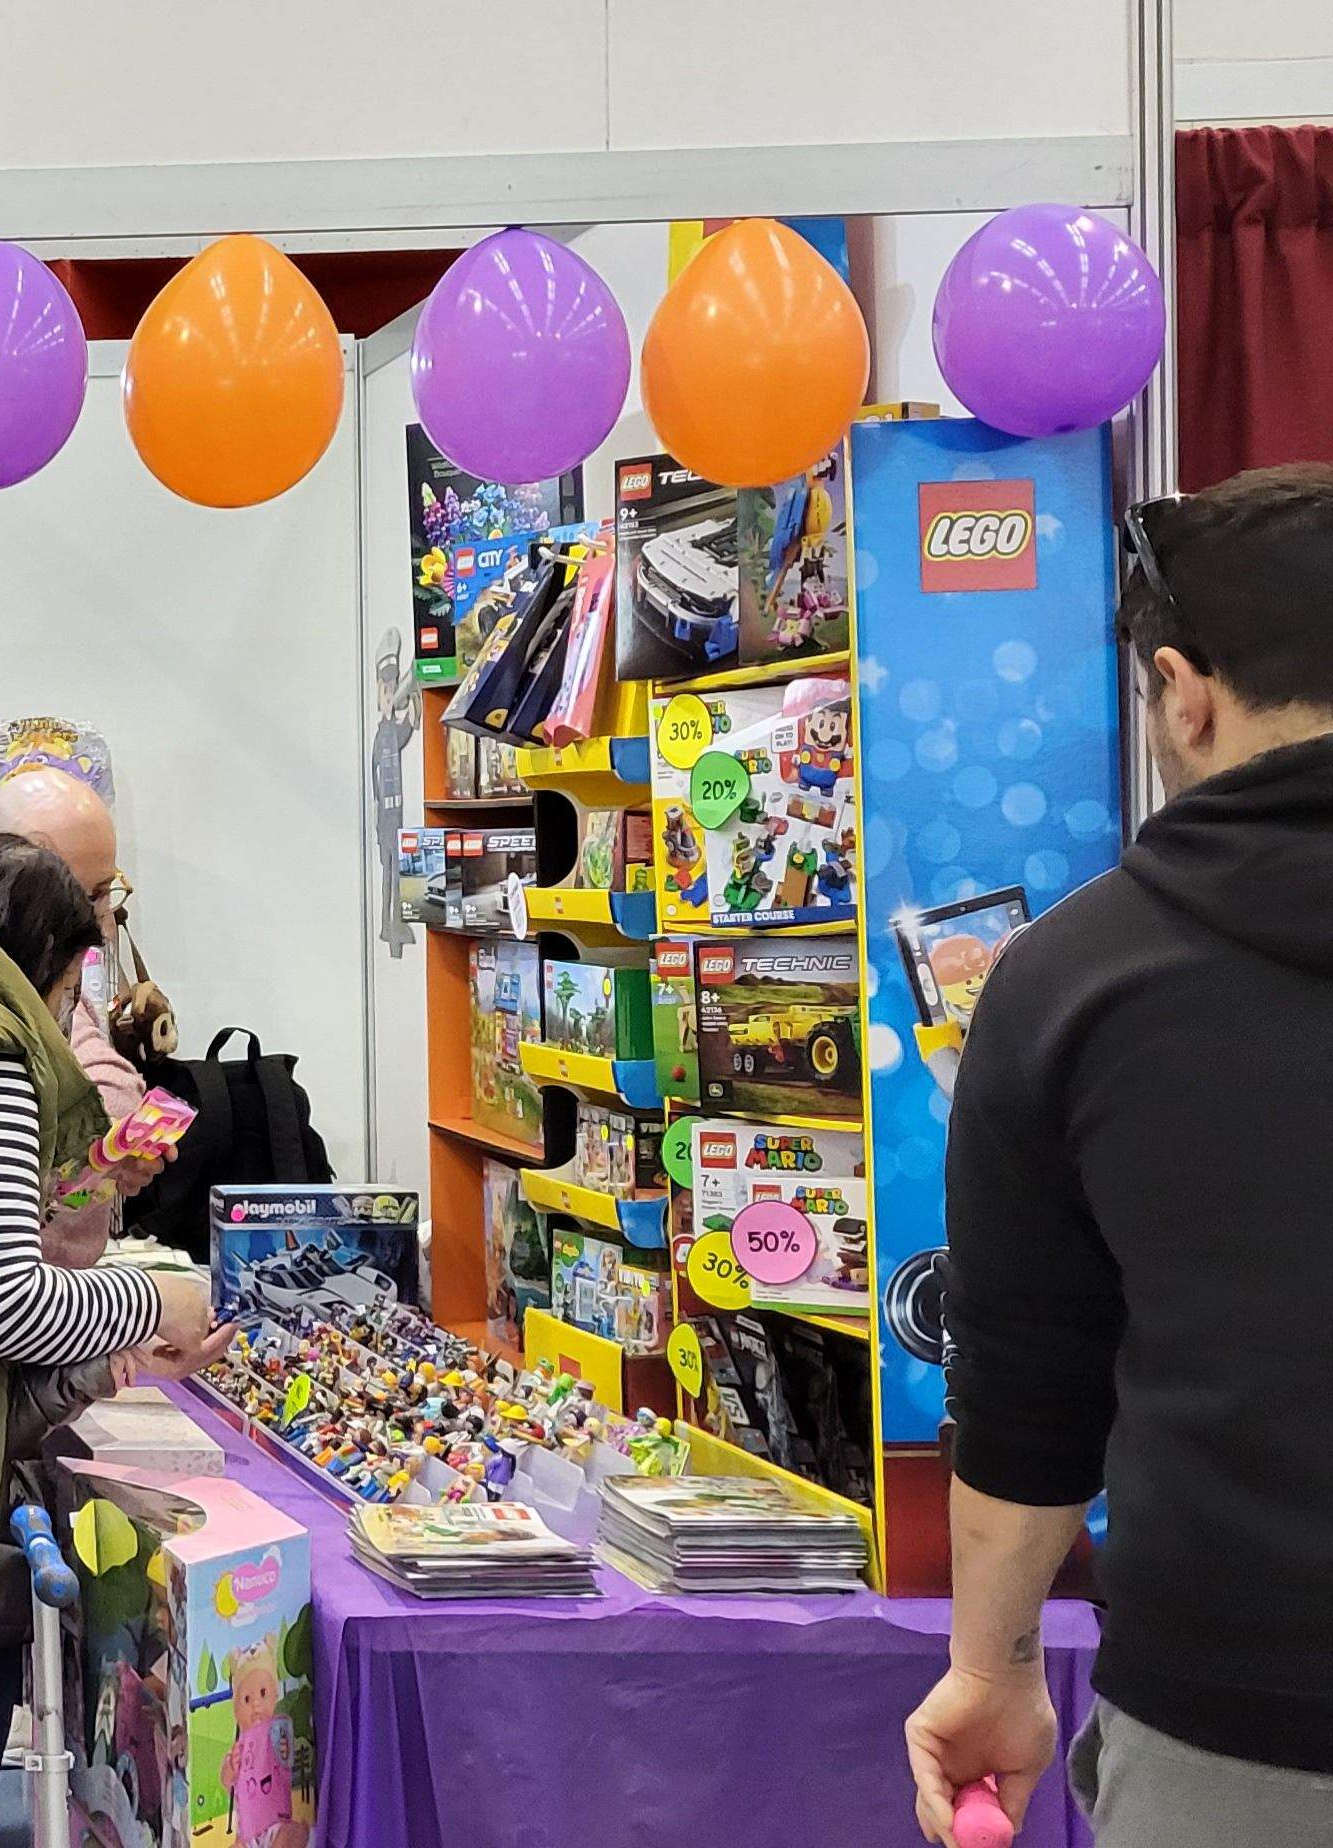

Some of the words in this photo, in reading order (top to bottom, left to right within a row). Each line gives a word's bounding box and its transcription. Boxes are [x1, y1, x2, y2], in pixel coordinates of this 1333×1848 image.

[622, 473, 650, 492] LEGO
[620, 507, 638, 519] 9+
[928, 513, 1029, 557] LEGO
[478, 549, 504, 568] CITY
[669, 719, 703, 741] 30%
[702, 780, 737, 801] 20%
[713, 912, 753, 924] STARTER
[754, 909, 795, 921] COURSE
[659, 951, 687, 965] LEGO
[702, 958, 732, 973] LEGO
[742, 955, 852, 972] TECHNIC
[657, 983, 674, 995] 7+
[701, 991, 721, 1004] 8+
[753, 1133, 814, 1151] SUPER
[744, 1149, 823, 1173] MARIO
[701, 1175, 721, 1187] 7+
[796, 1185, 843, 1200] SUPER
[747, 1230, 801, 1254] 50%
[702, 1252, 749, 1290] 30%
[678, 1348, 699, 1373] 30%
